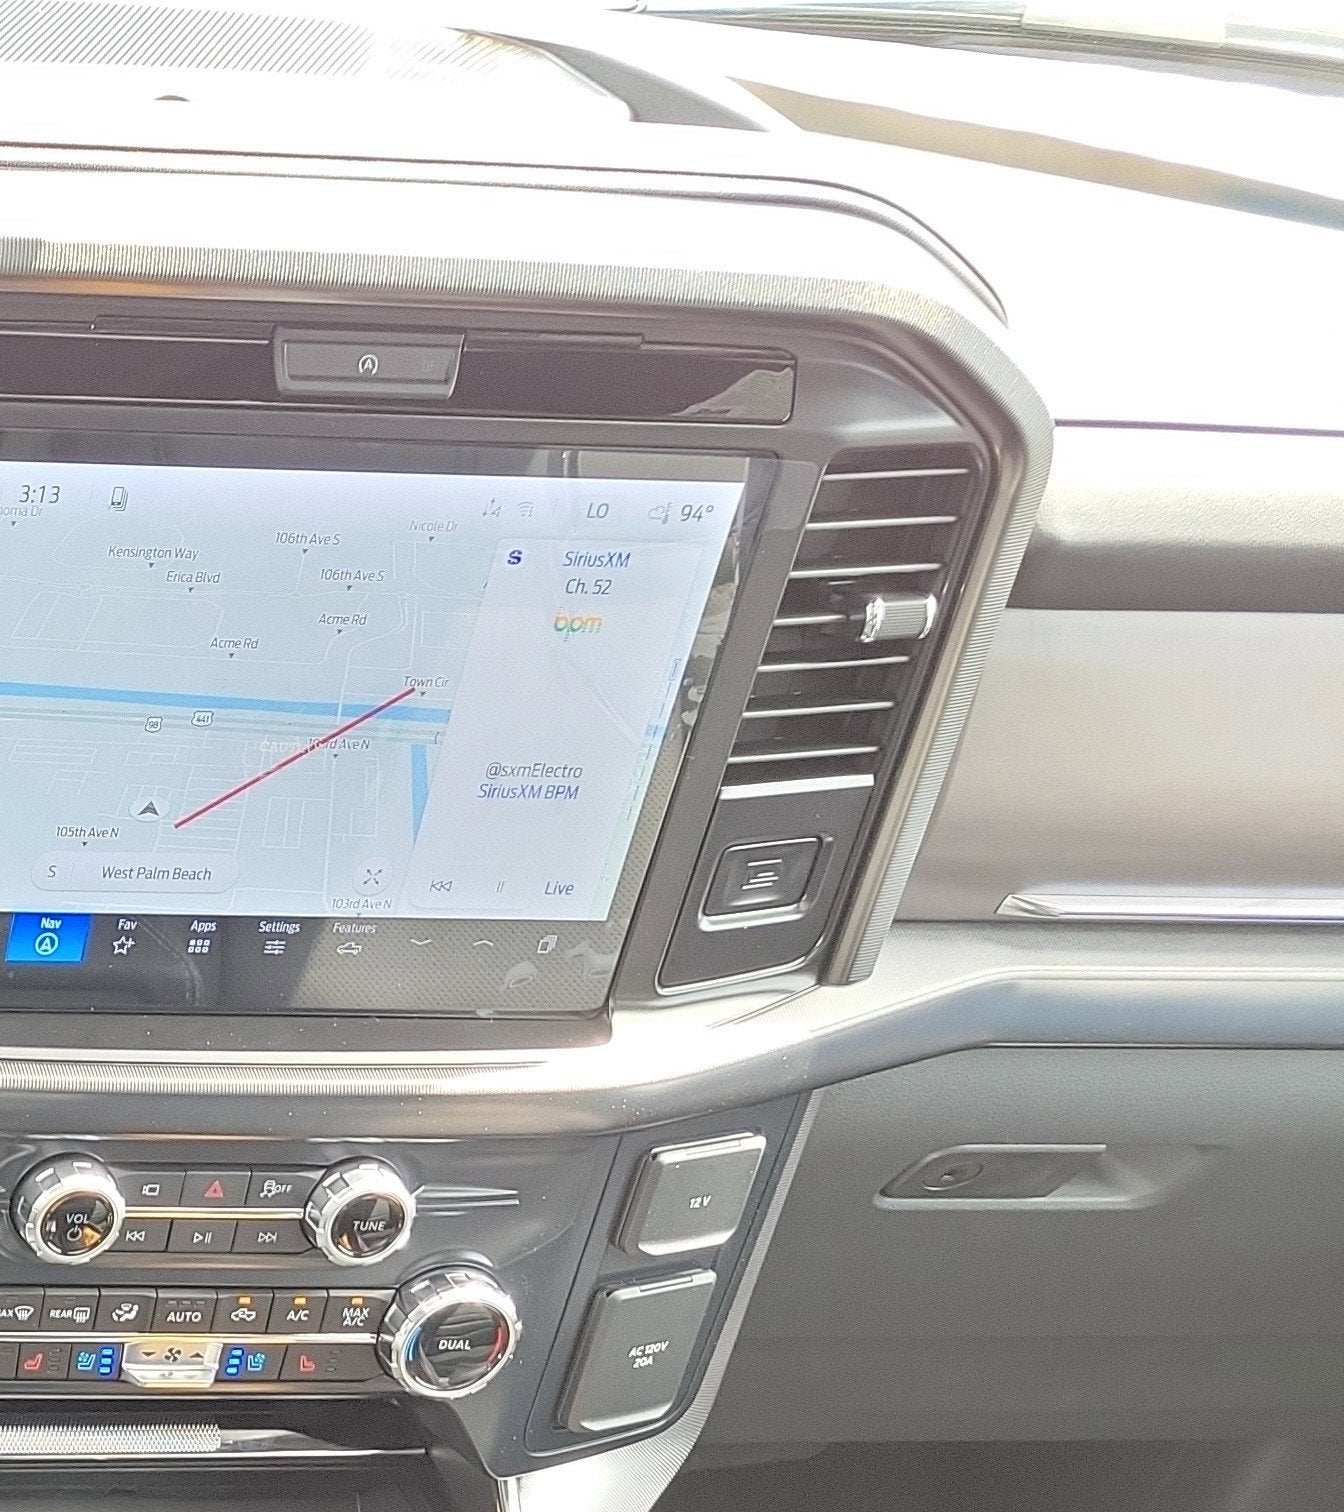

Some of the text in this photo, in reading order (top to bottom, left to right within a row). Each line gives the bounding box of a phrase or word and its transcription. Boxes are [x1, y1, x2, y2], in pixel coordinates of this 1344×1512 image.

[18, 485, 61, 504] 3:13
[29, 505, 43, 518] Dr
[587, 503, 609, 520] LO
[275, 531, 341, 546] 106th Ave S
[108, 545, 200, 562] Kensington Way
[562, 551, 632, 569] SiriusXM
[166, 570, 221, 585] Erica Blvd
[320, 568, 385, 583] 106th Ave S
[565, 578, 613, 595] Ch. 52
[318, 612, 368, 627] Acme Rd
[210, 636, 259, 651] Acme Rd
[403, 674, 432, 688] Town
[340, 739, 359, 750] Ave
[360, 739, 371, 750] N
[486, 762, 583, 780] @sxmElectro
[478, 783, 580, 800] SiriusXM BPM
[55, 826, 119, 838] 105th Ave N
[47, 865, 212, 881] S West Palm Beach
[544, 881, 574, 896] Live
[331, 898, 391, 910] 103rd Ave N
[40, 917, 62, 929] Nav
[117, 918, 138, 931] Fav
[190, 919, 217, 934] Apps
[258, 920, 301, 935] Settings
[332, 922, 377, 934] Features
[273, 1183, 293, 1194] OFF
[66, 1213, 90, 1225] VOL
[352, 1220, 386, 1232] TUNE
[49, 1309, 73, 1319] REAR
[166, 1311, 202, 1323] AUTO
[286, 1309, 310, 1322] A/C
[342, 1307, 370, 1318] MAX
[342, 1316, 366, 1327] A/C
[438, 1339, 472, 1351] DUAL
